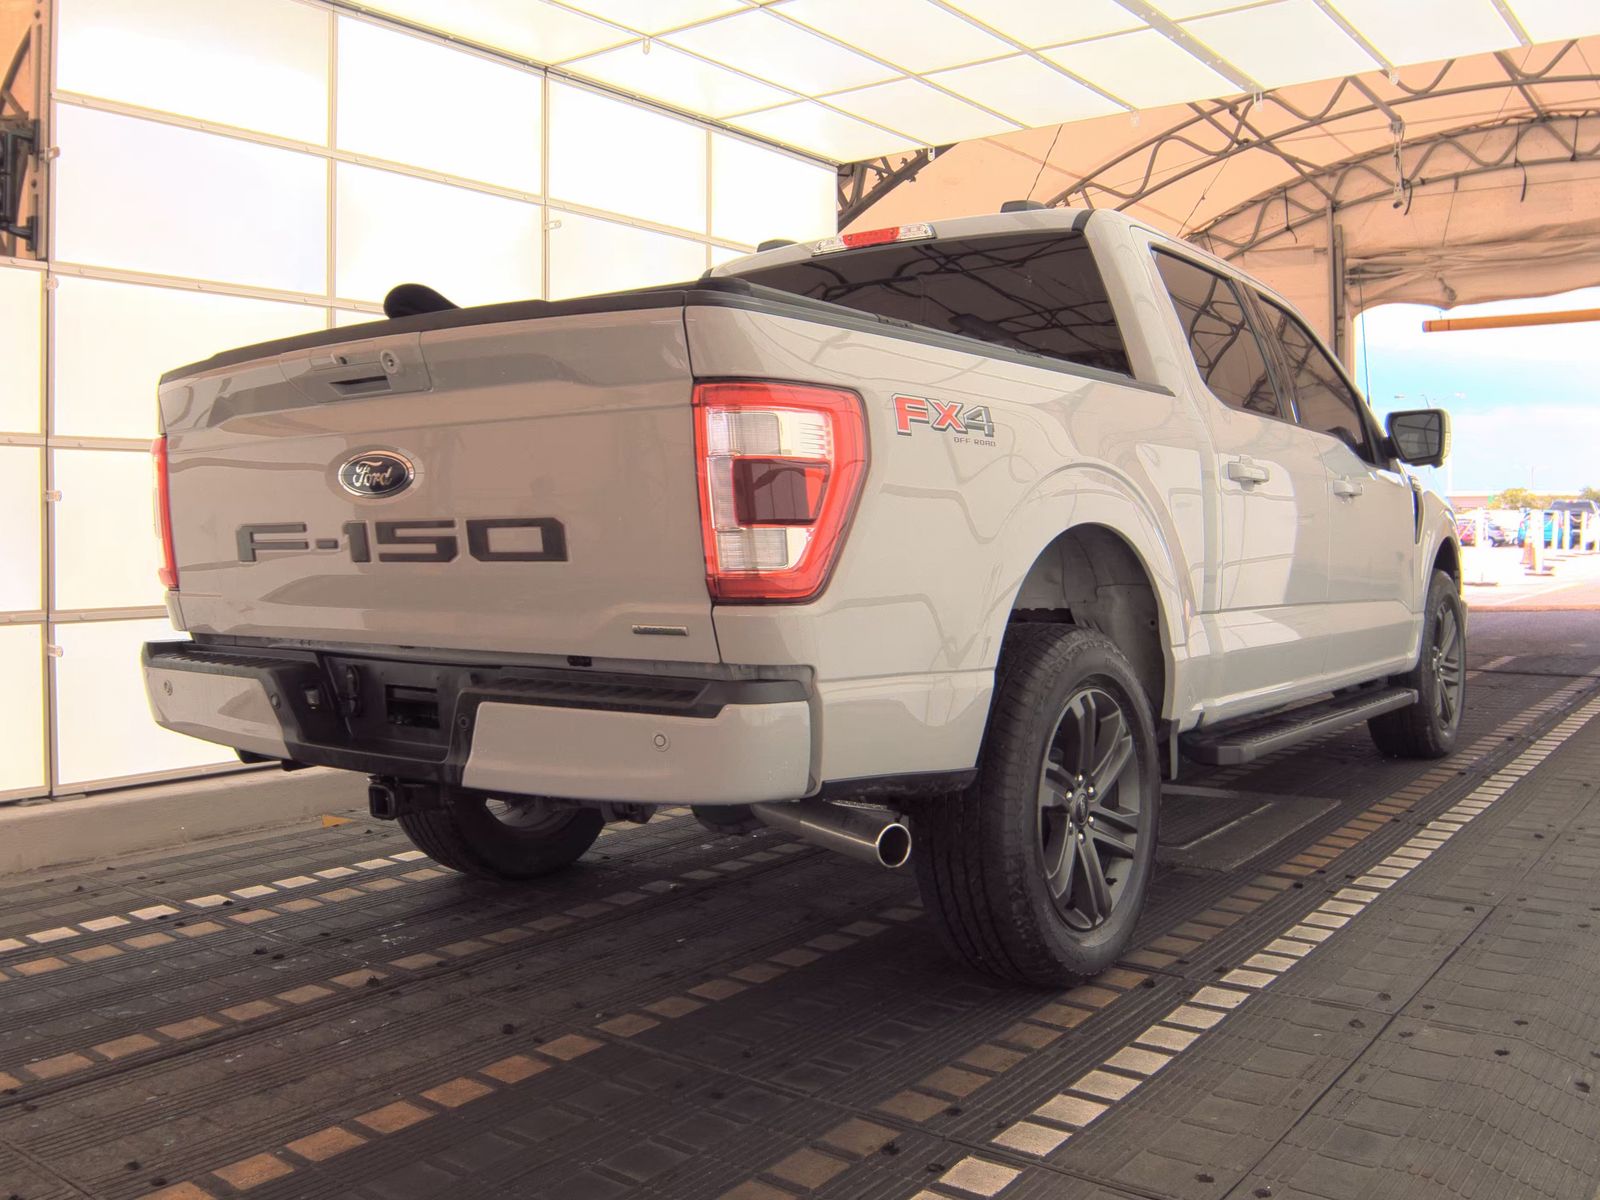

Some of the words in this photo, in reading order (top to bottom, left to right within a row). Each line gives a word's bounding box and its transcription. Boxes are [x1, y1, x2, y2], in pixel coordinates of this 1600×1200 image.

[891, 393, 994, 437] FX4
[953, 436, 971, 444] OFF
[974, 438, 996, 447] ROAD
[352, 460, 394, 487] Ford
[236, 517, 568, 563] F-150
